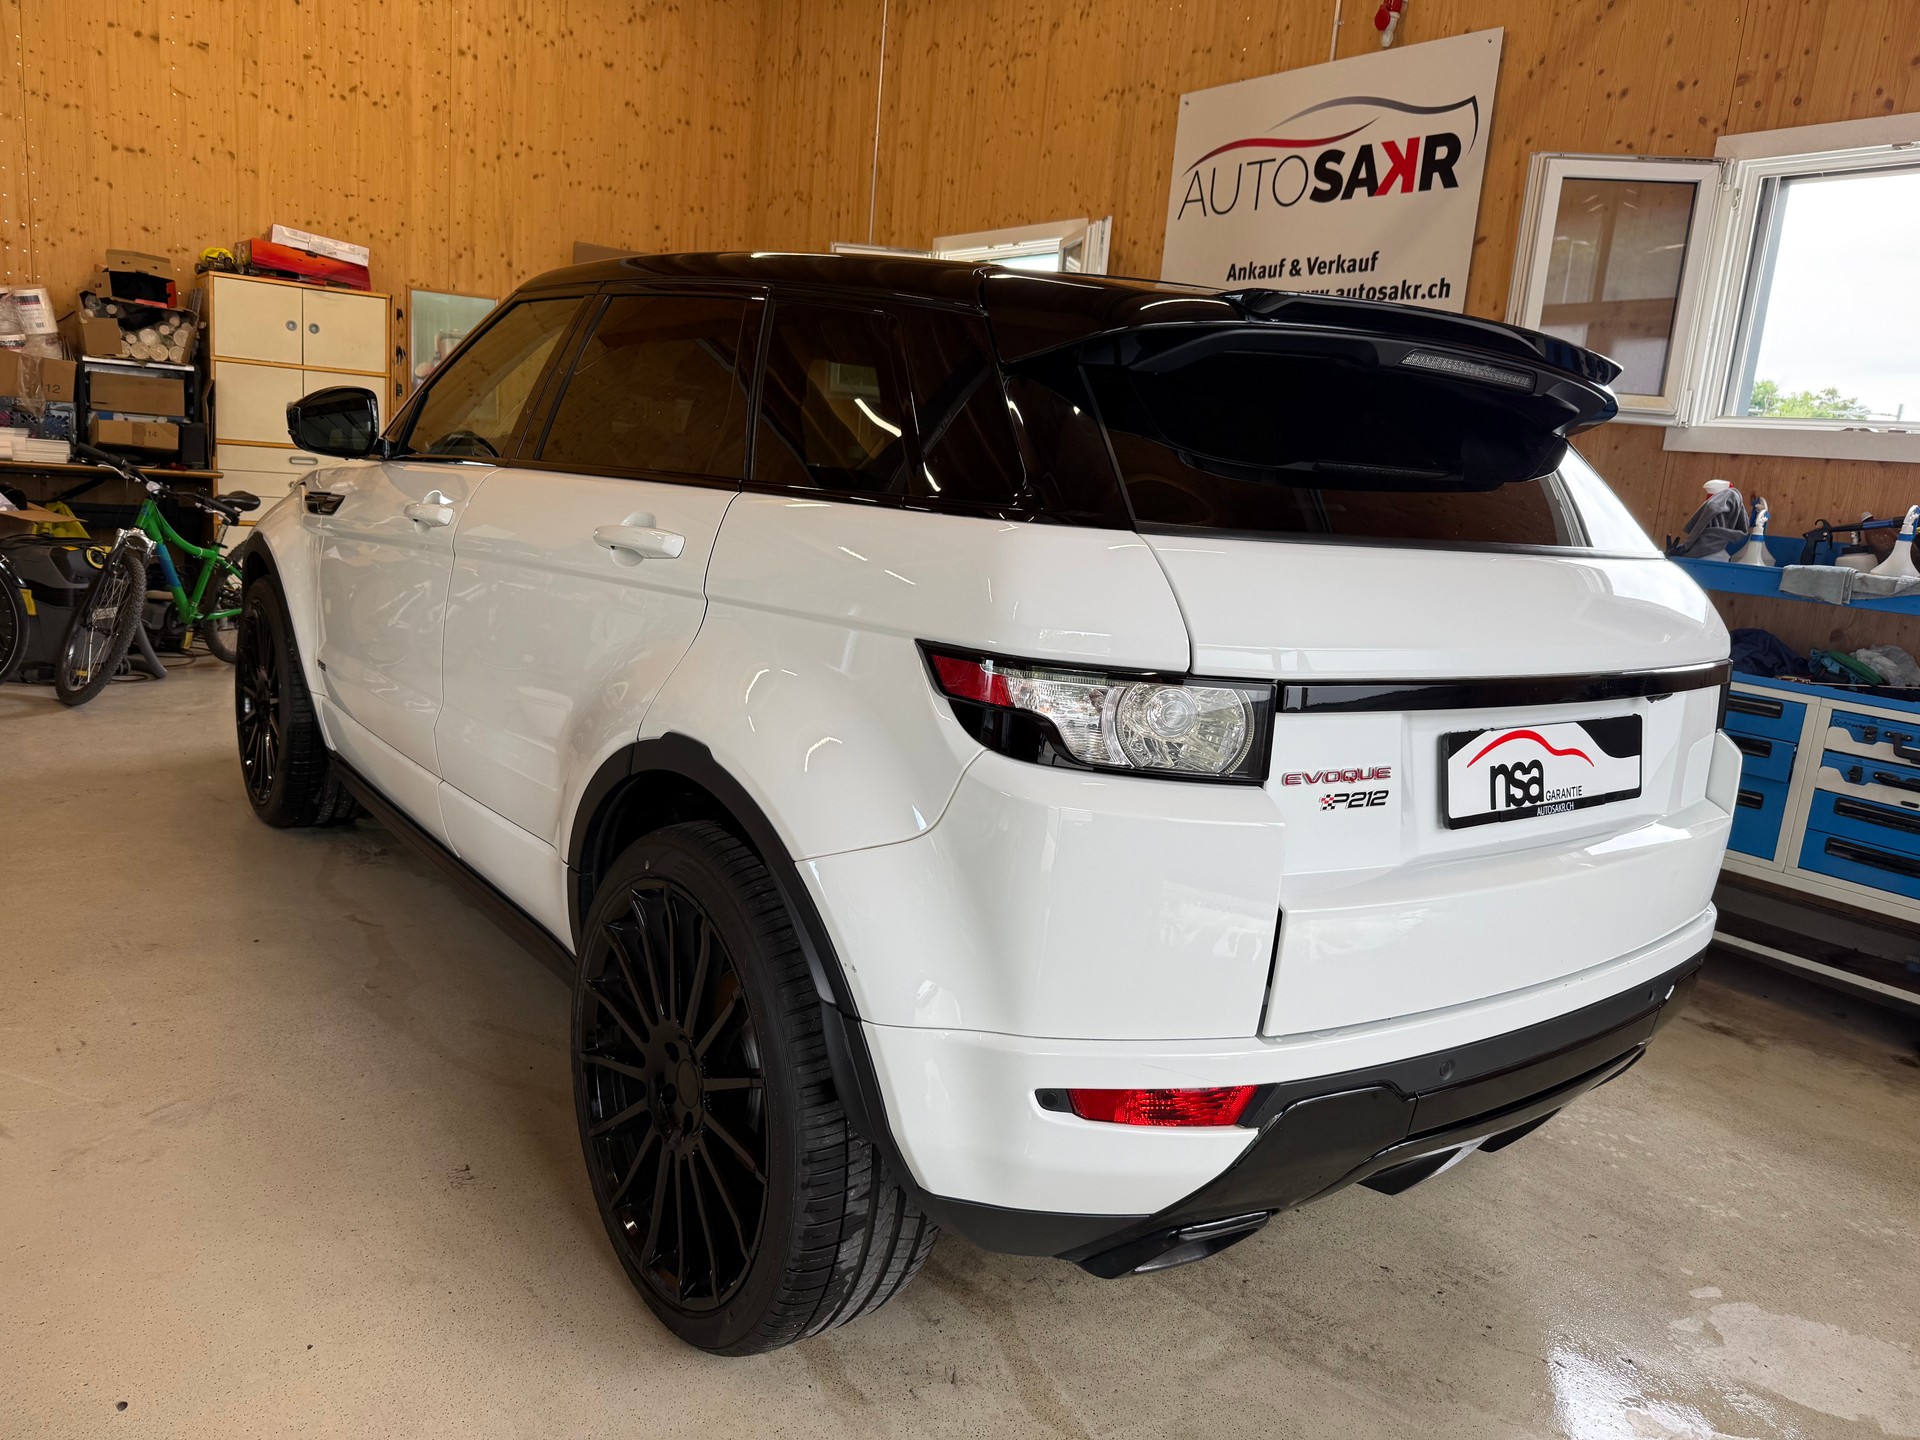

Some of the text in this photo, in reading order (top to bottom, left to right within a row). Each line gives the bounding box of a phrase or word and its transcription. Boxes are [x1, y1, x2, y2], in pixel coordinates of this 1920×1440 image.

[1177, 132, 1462, 220] AUTOSAKR
[1226, 250, 1380, 282] Ankauf & Verkauf
[1298, 277, 1452, 301] autosakr.ch
[46, 384, 61, 394] 12
[1282, 765, 1392, 786] EVOQUE
[1490, 759, 1545, 810] nsa
[1332, 790, 1389, 809] P212
[1545, 785, 1583, 802] GARANTIE
[1536, 801, 1575, 817] AUTOSAKR.CH
